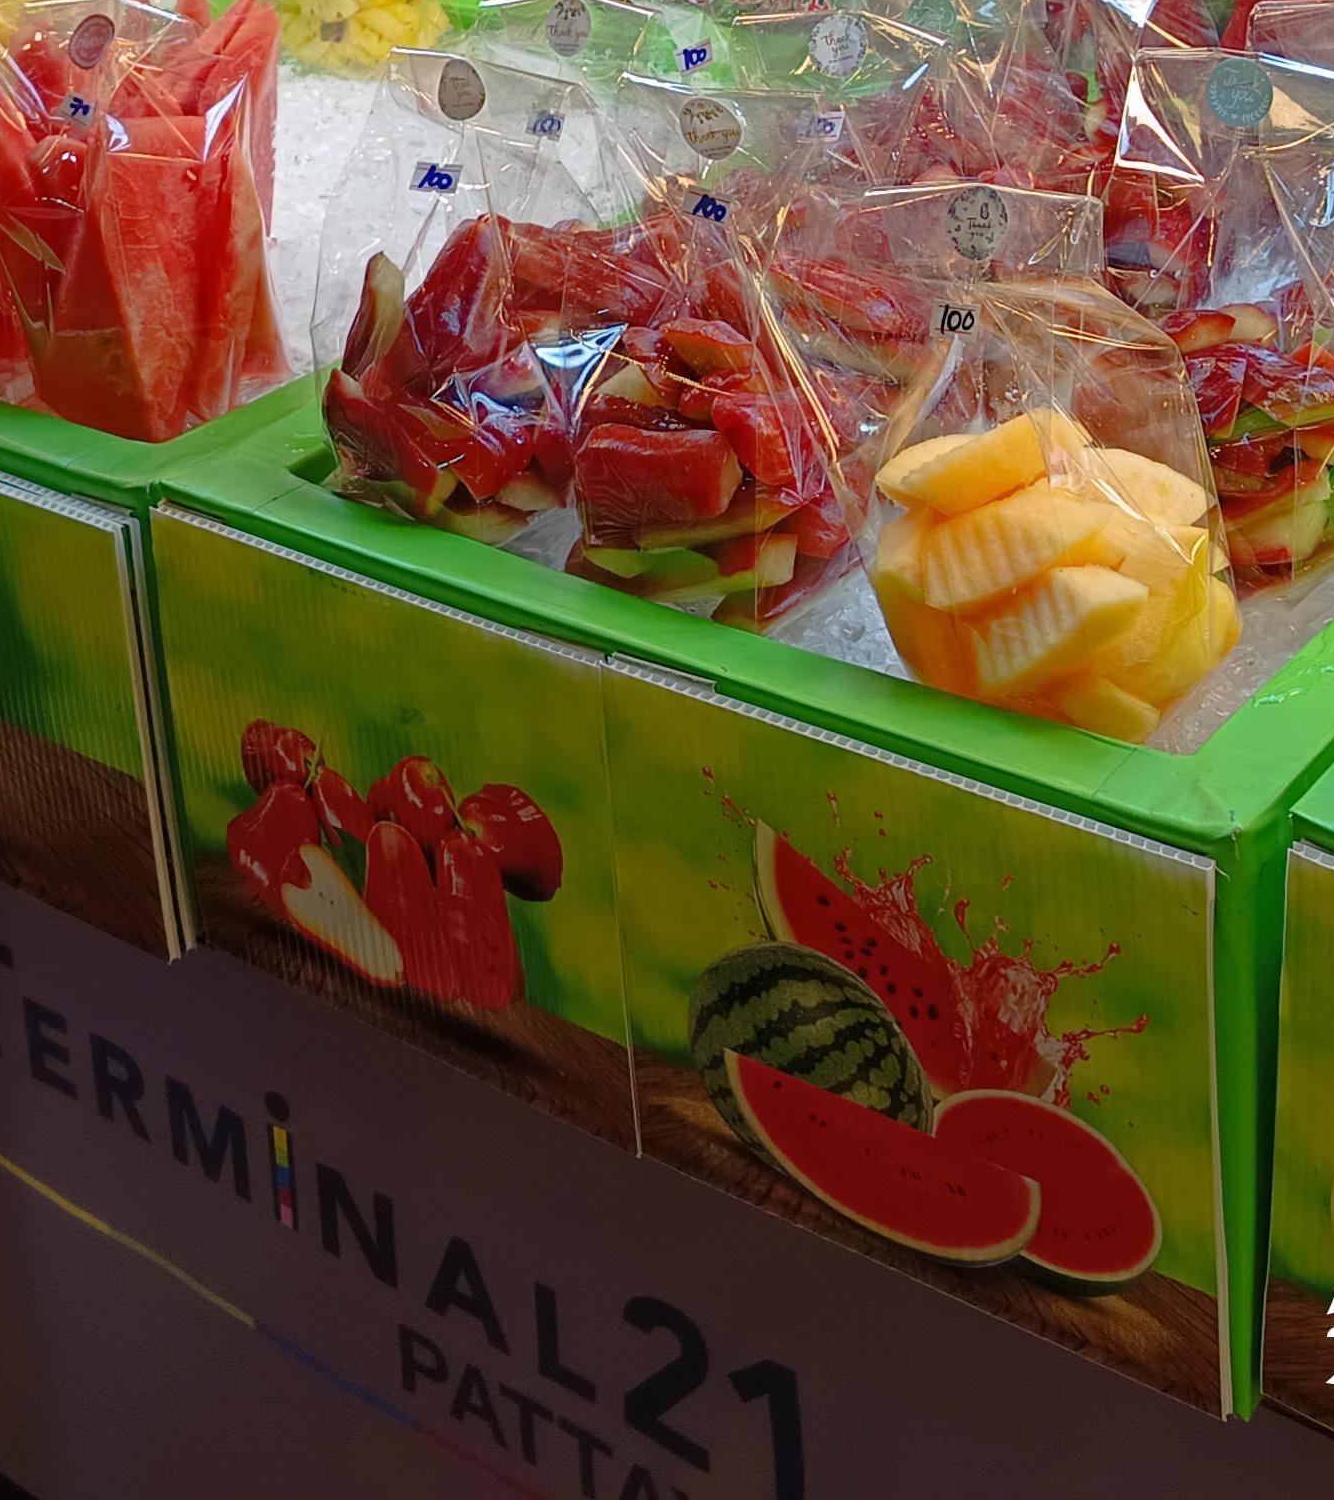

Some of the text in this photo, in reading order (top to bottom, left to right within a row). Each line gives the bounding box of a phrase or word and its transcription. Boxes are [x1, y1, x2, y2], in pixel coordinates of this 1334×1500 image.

[682, 48, 707, 70] 100
[418, 164, 453, 190] 100
[693, 194, 727, 221] 100
[939, 306, 975, 334] 100
[398, 1322, 693, 1500] PATTA
